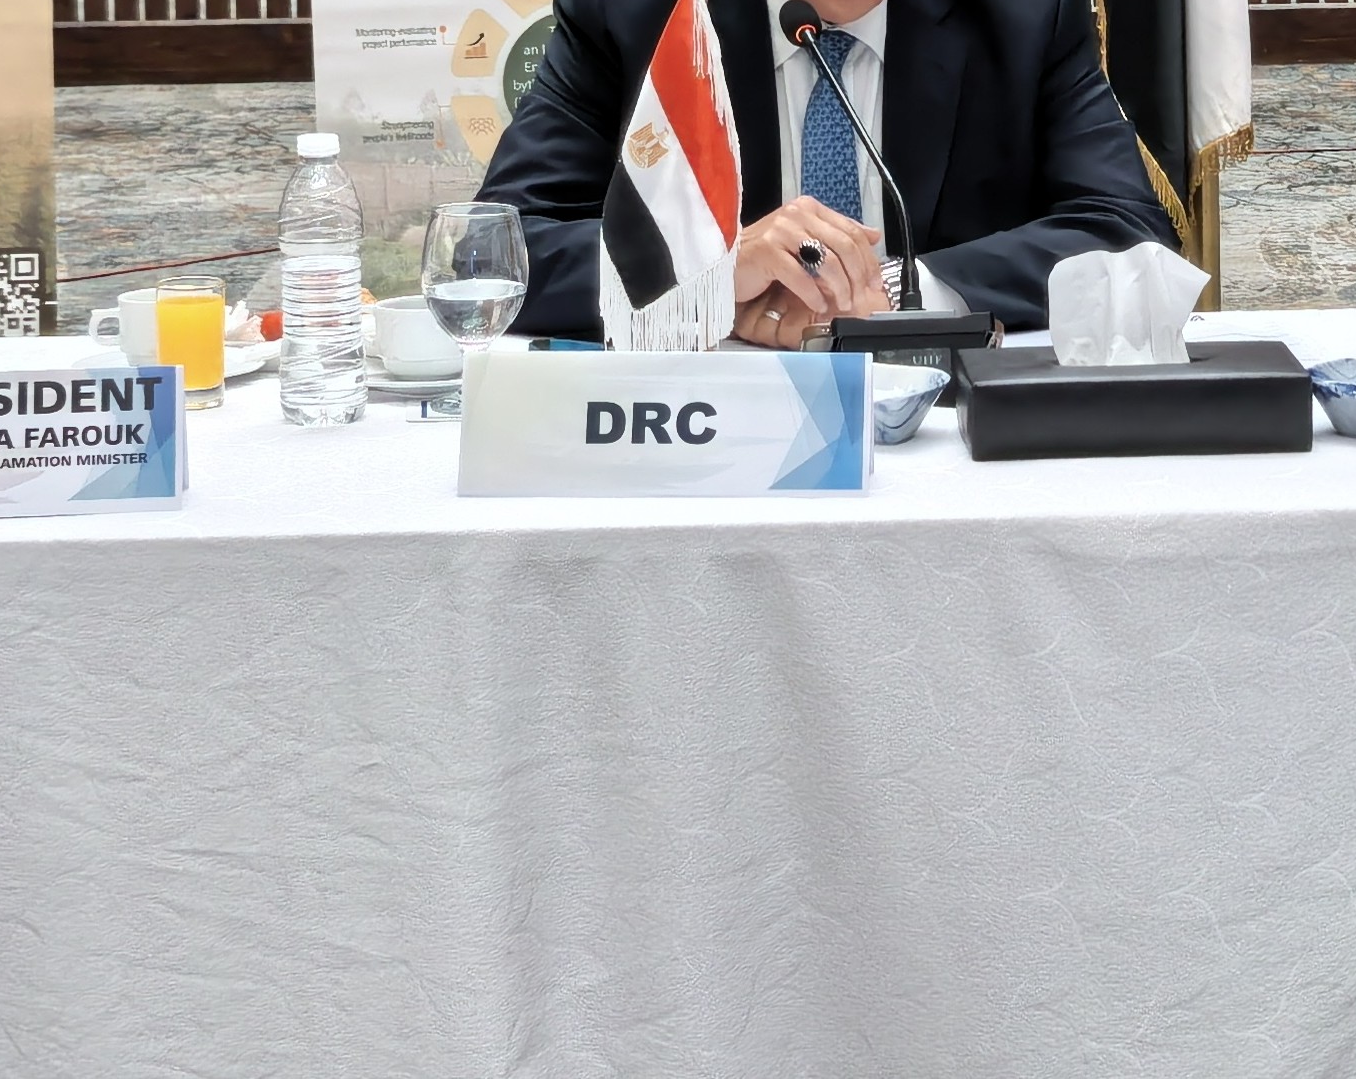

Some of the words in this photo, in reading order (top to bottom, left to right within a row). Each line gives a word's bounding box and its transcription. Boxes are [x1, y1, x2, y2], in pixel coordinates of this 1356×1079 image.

[585, 402, 717, 445] DRC
[25, 424, 144, 448] FAROUK
[76, 453, 147, 466] MINISTER
